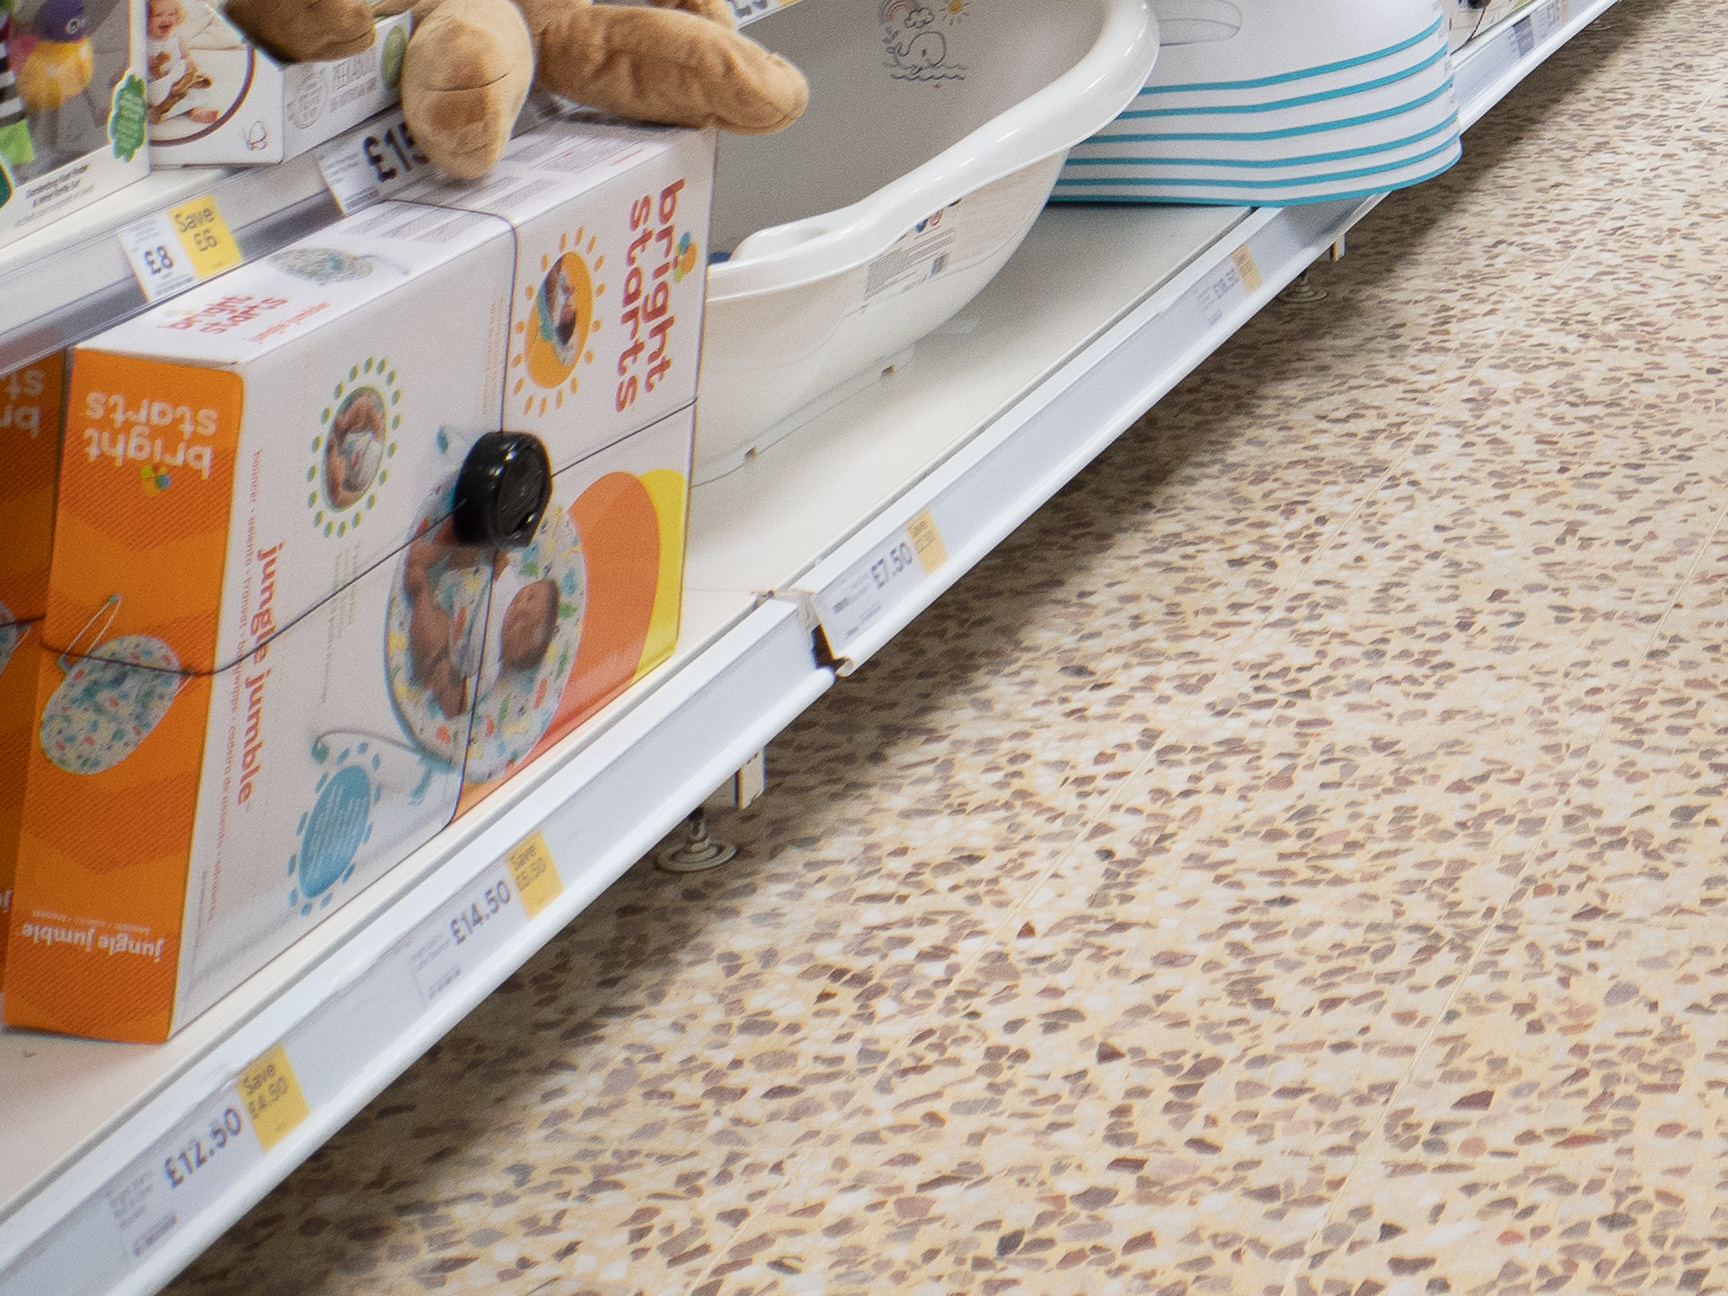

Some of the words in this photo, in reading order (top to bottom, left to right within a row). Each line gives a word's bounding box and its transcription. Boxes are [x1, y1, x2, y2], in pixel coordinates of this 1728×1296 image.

[174, 206, 215, 236] Save
[194, 224, 219, 253] £6
[144, 245, 175, 276] £8
[614, 194, 652, 414] starts
[644, 177, 686, 394] bright
[85, 390, 219, 441] starts
[84, 424, 214, 482] bright
[871, 542, 913, 590] £7.50
[248, 541, 285, 660] jungle
[236, 669, 267, 807] jumble
[509, 843, 538, 870] Save
[22, 922, 94, 948] jumble
[449, 878, 512, 946] £14.50
[98, 932, 166, 964] jungle
[241, 1061, 277, 1095] Save
[245, 1077, 290, 1120] £4.50
[162, 1107, 244, 1190] £12.50
